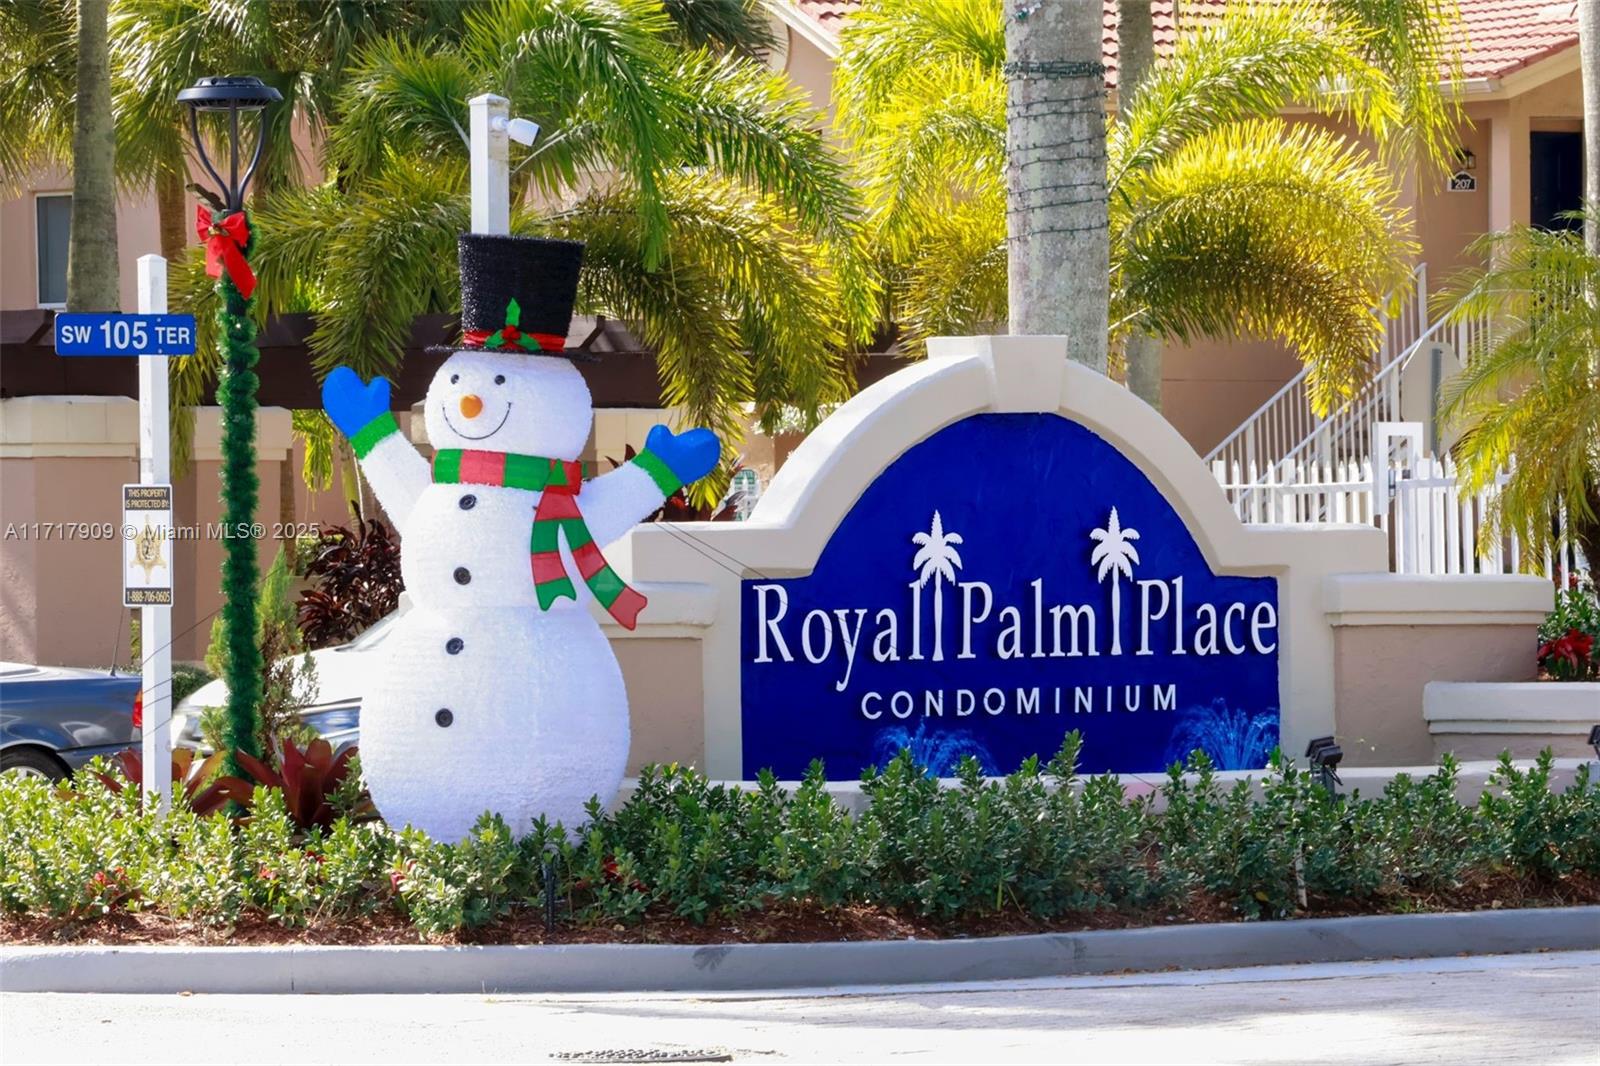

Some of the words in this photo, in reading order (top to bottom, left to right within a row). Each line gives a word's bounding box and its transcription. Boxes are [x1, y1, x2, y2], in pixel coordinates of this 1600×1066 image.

[1455, 179, 1472, 189] 207
[61, 325, 92, 344] SW
[100, 320, 148, 350] 105
[154, 326, 190, 345] TER
[128, 488, 140, 498] THIS
[141, 488, 168, 498] PROPERTY
[131, 499, 161, 509] PROTECTED
[752, 579, 924, 692] Royal
[957, 577, 1100, 659] Palm
[1136, 575, 1278, 656] Place
[860, 683, 1178, 721] CONDOMINIUM
